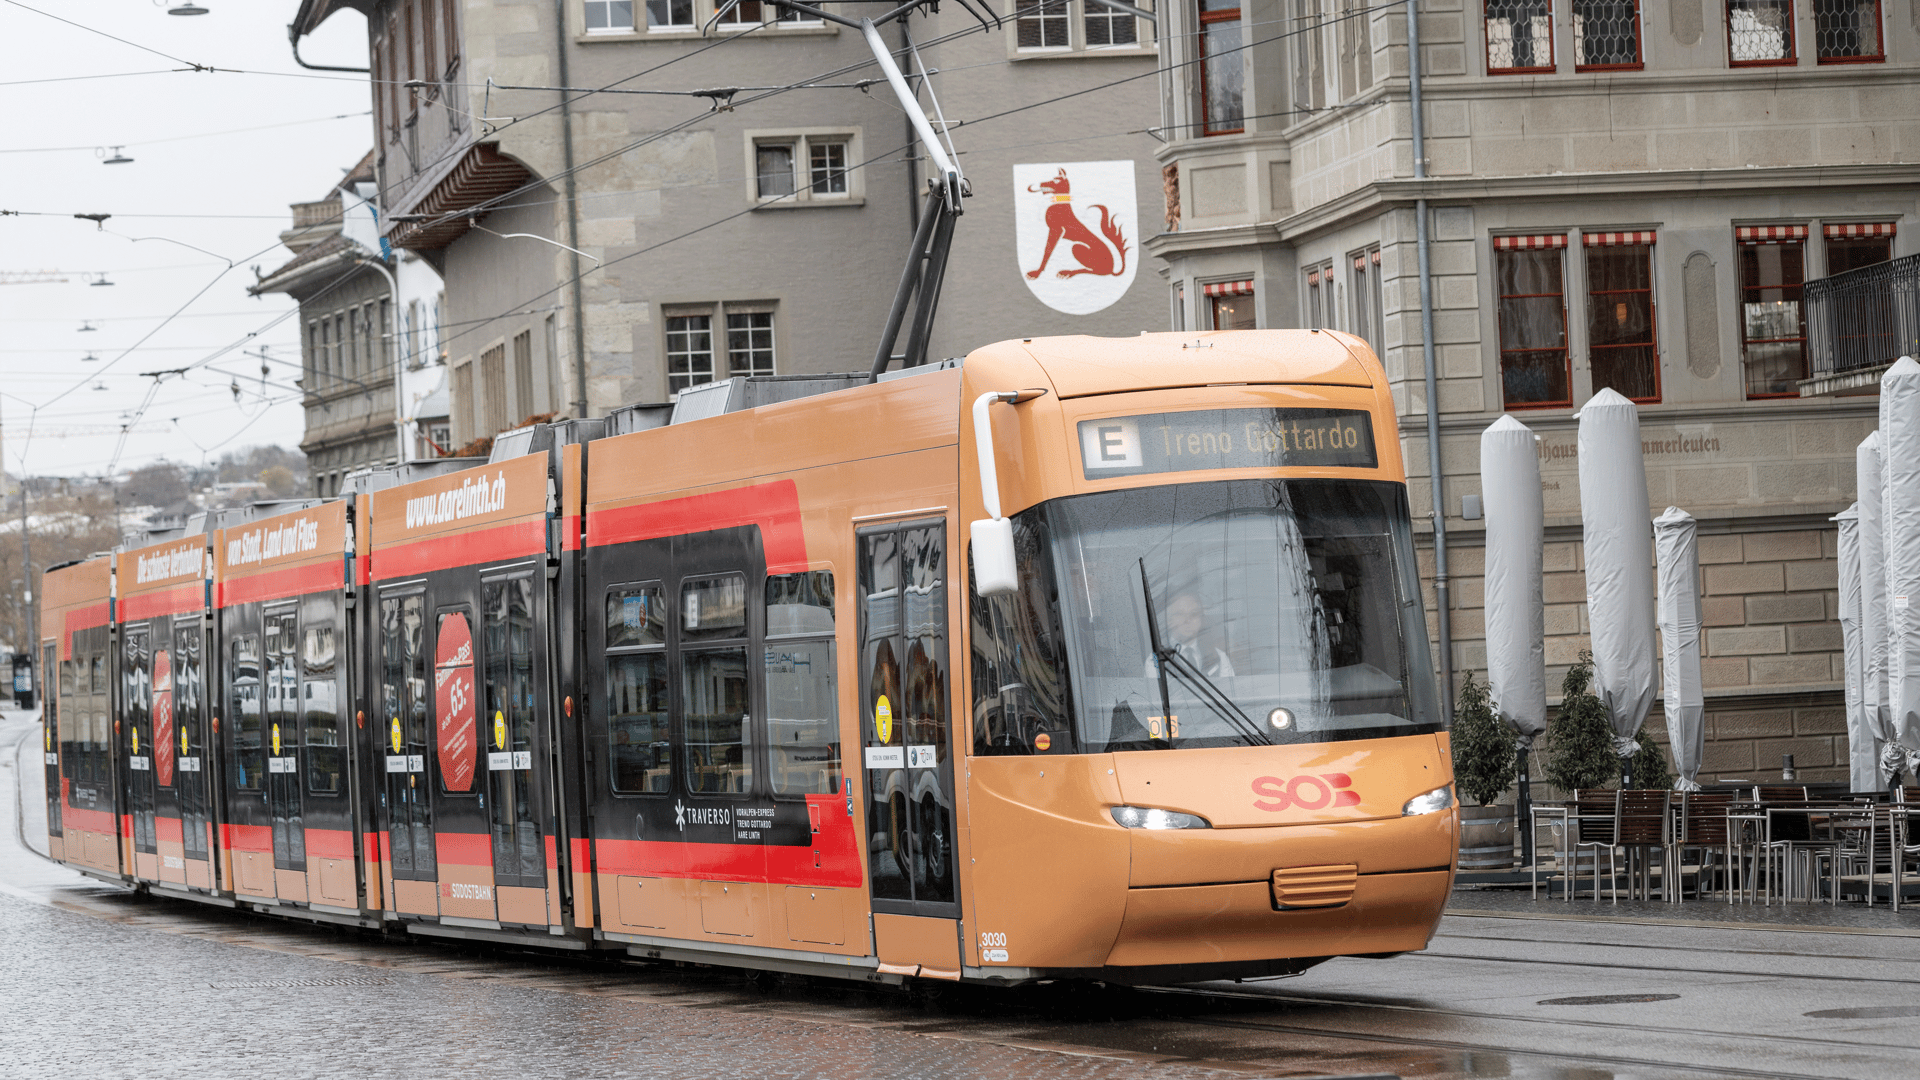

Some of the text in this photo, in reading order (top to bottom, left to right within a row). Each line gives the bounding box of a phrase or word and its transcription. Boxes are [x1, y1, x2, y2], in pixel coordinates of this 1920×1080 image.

[1098, 426, 1126, 461] E
[1159, 419, 1357, 455] Treno Gottardo
[406, 470, 505, 530] www.aarelinth.ch
[241, 528, 262, 566] Stadt,
[263, 523, 283, 560] Land
[282, 519, 299, 556] und
[297, 517, 318, 554] Fluss
[687, 808, 730, 825] TRAVERSO
[736, 808, 775, 817] VORALPEN-EXPRESS
[737, 819, 772, 829] TRENO GOTTARDO
[738, 831, 761, 839] AARE LINTH
[982, 932, 1007, 946] 3030
